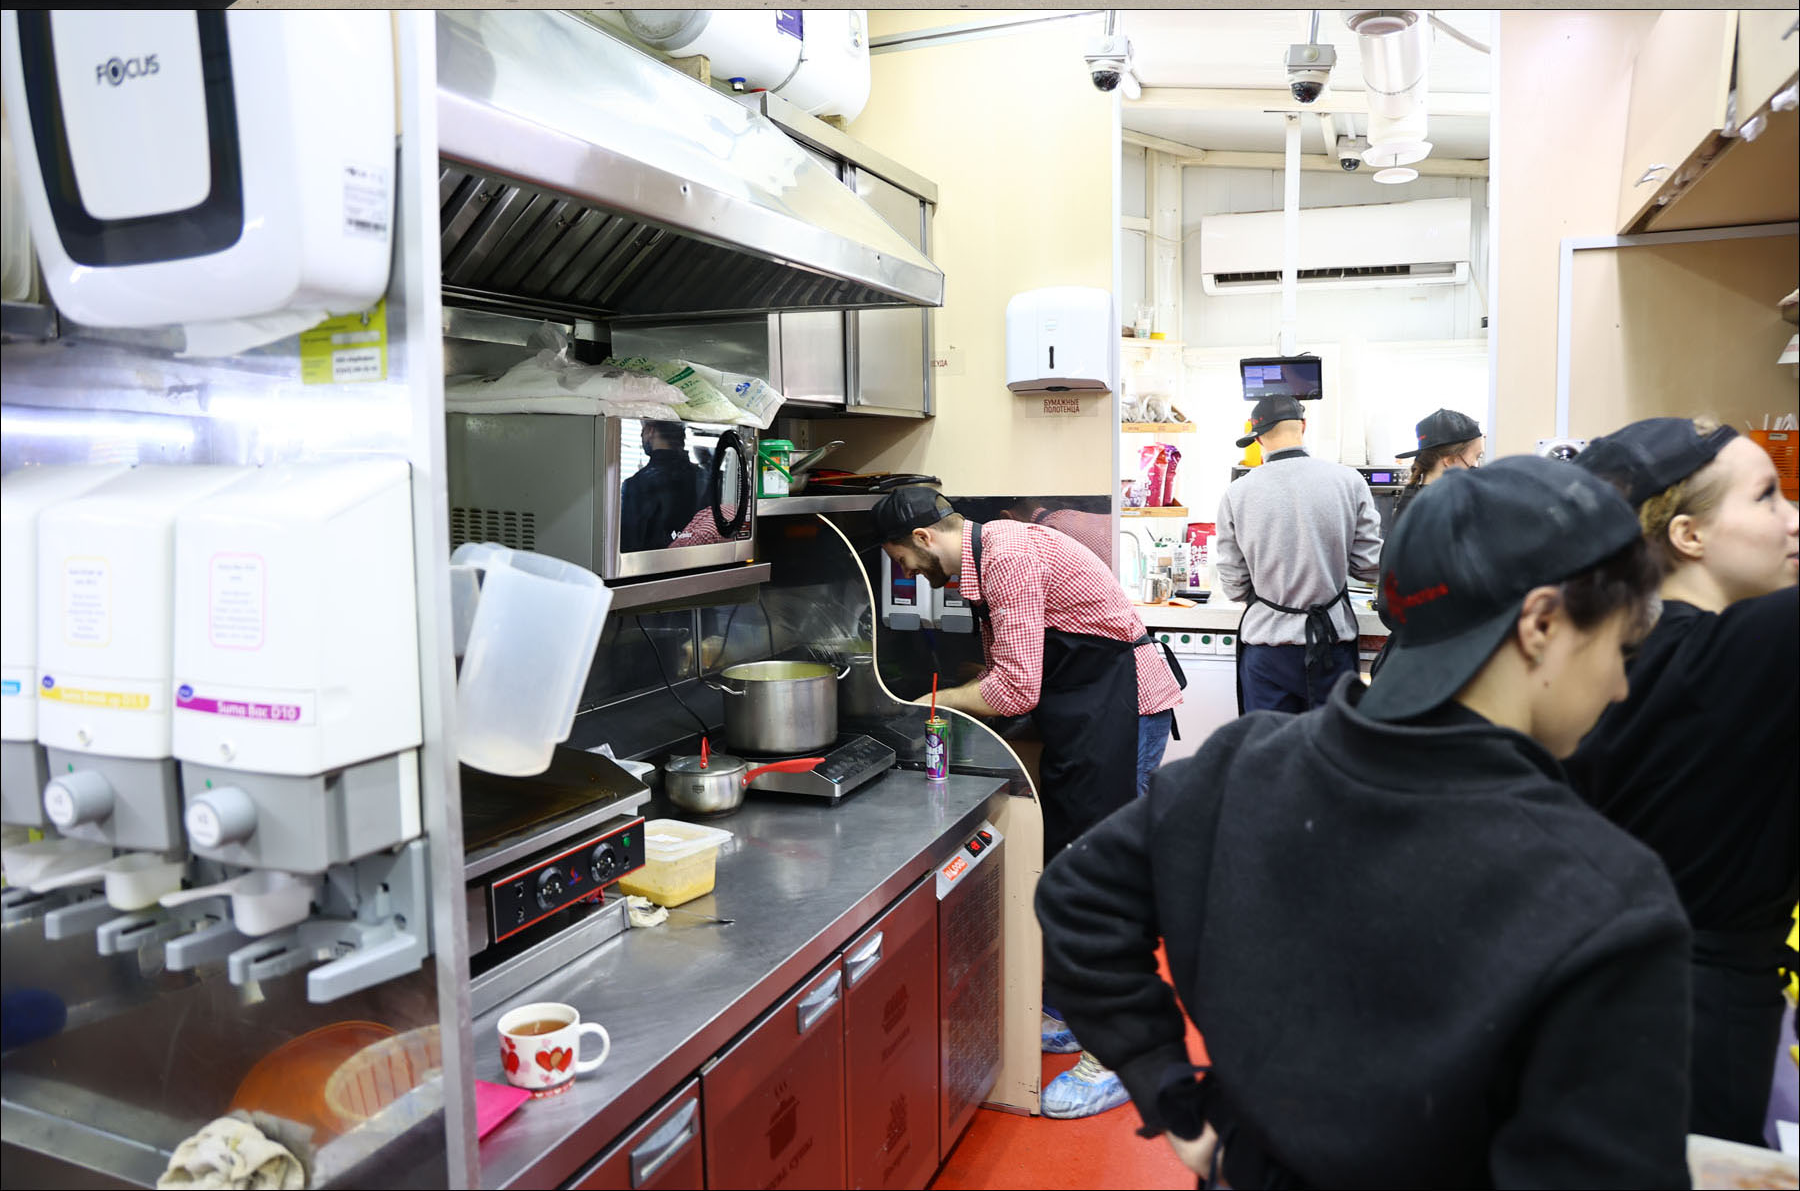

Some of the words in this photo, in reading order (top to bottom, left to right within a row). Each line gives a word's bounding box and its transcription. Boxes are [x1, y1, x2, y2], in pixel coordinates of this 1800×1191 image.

[96, 53, 160, 86] FOCUS
[1043, 398, 1080, 406] БУМАЖНЫЕ
[1043, 405, 1080, 414] ПОЛОТЕНЦА
[217, 700, 246, 716] Suma
[248, 702, 269, 717] Bac
[272, 704, 297, 720] D10
